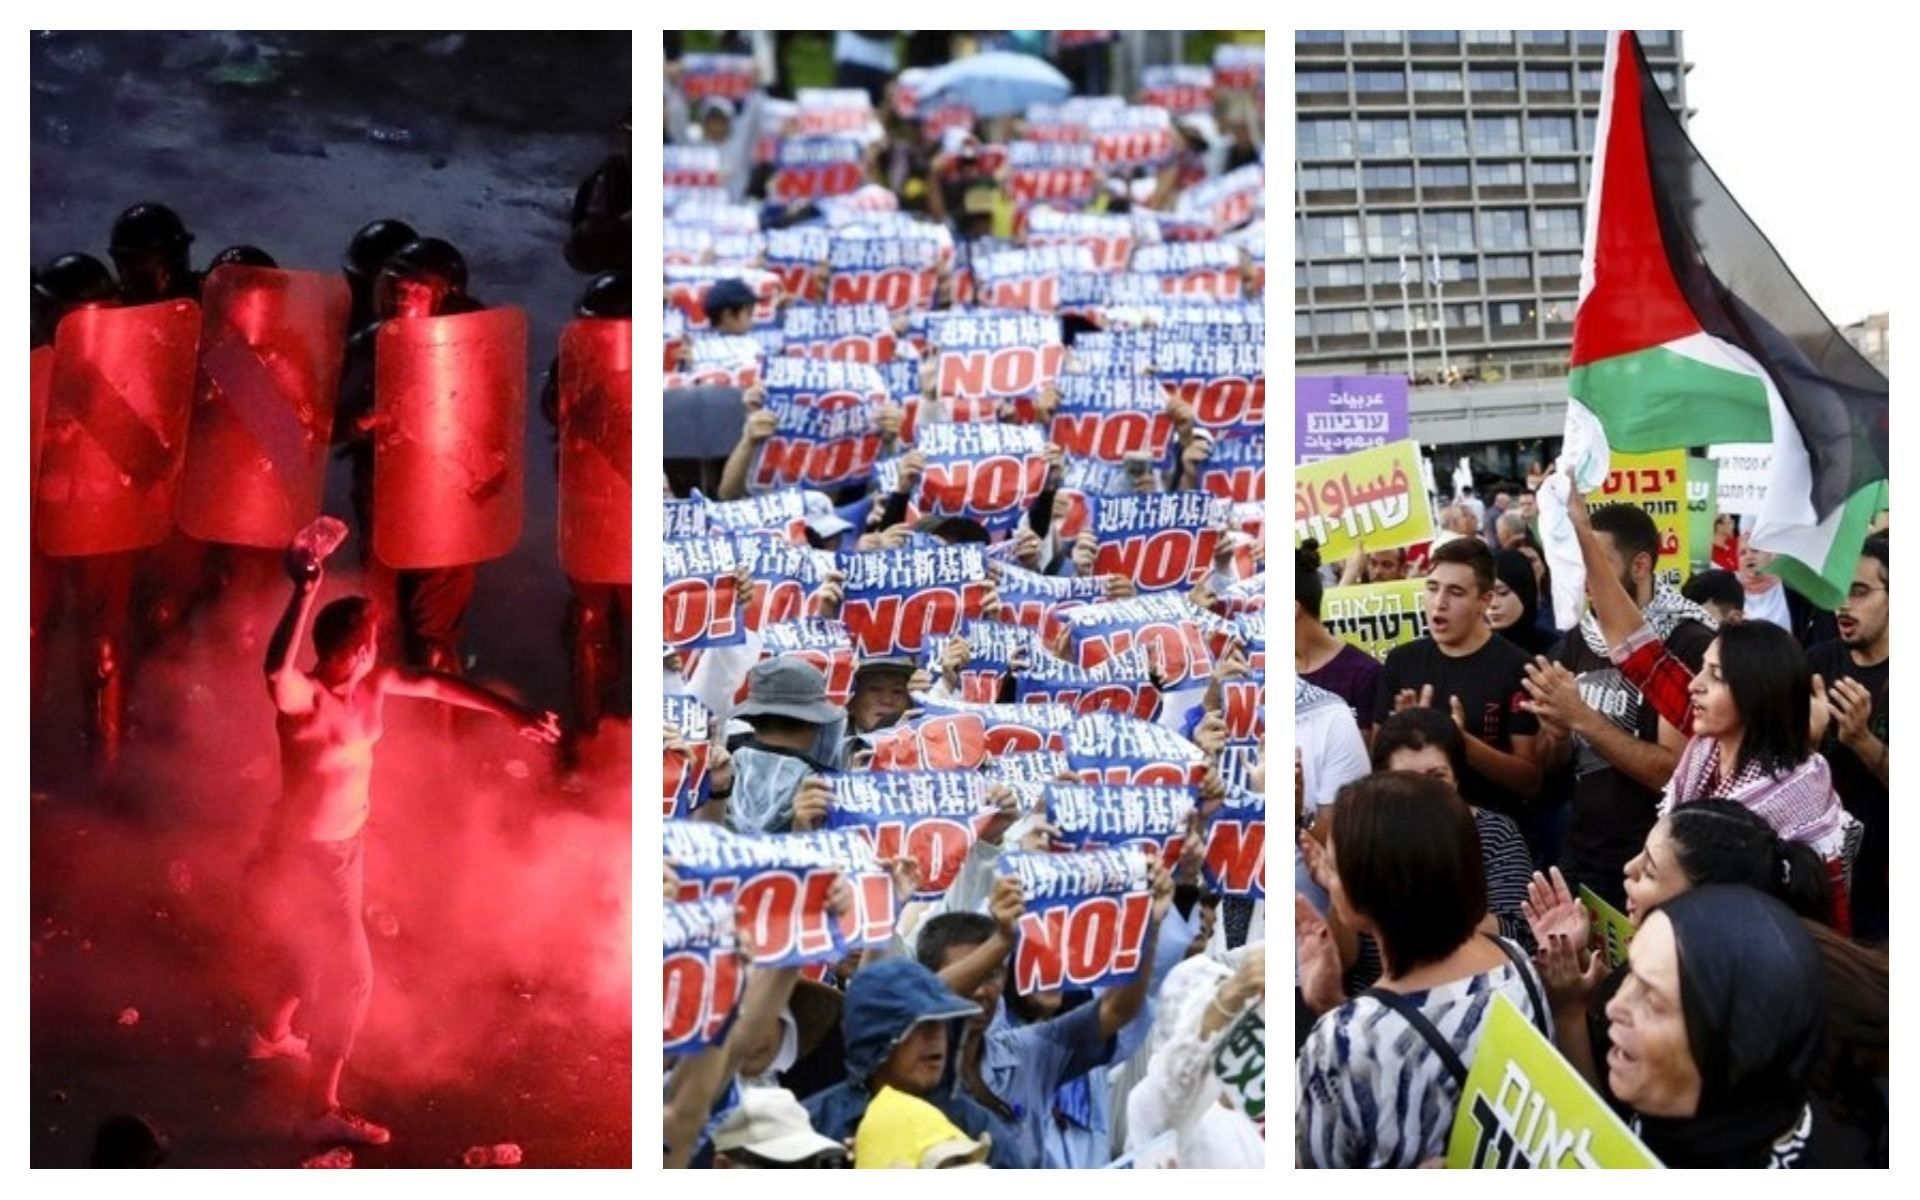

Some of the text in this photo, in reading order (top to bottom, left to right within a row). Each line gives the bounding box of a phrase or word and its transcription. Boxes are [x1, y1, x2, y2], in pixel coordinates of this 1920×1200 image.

[828, 268, 940, 311] NO!
[940, 345, 1066, 400] NO!
[1312, 414, 1385, 430] ערביות
[1327, 391, 1385, 409] عربيات
[754, 432, 886, 488] NO!
[1050, 410, 1174, 464] NO!
[918, 453, 1050, 517] NO!
[1098, 492, 1232, 533] 辺野古新基地
[839, 544, 985, 592] 辺野古新基地
[1093, 527, 1220, 592] NO!
[1327, 591, 1401, 621] הלאום
[674, 868, 836, 963] O!
[1014, 891, 1153, 996] NO!
